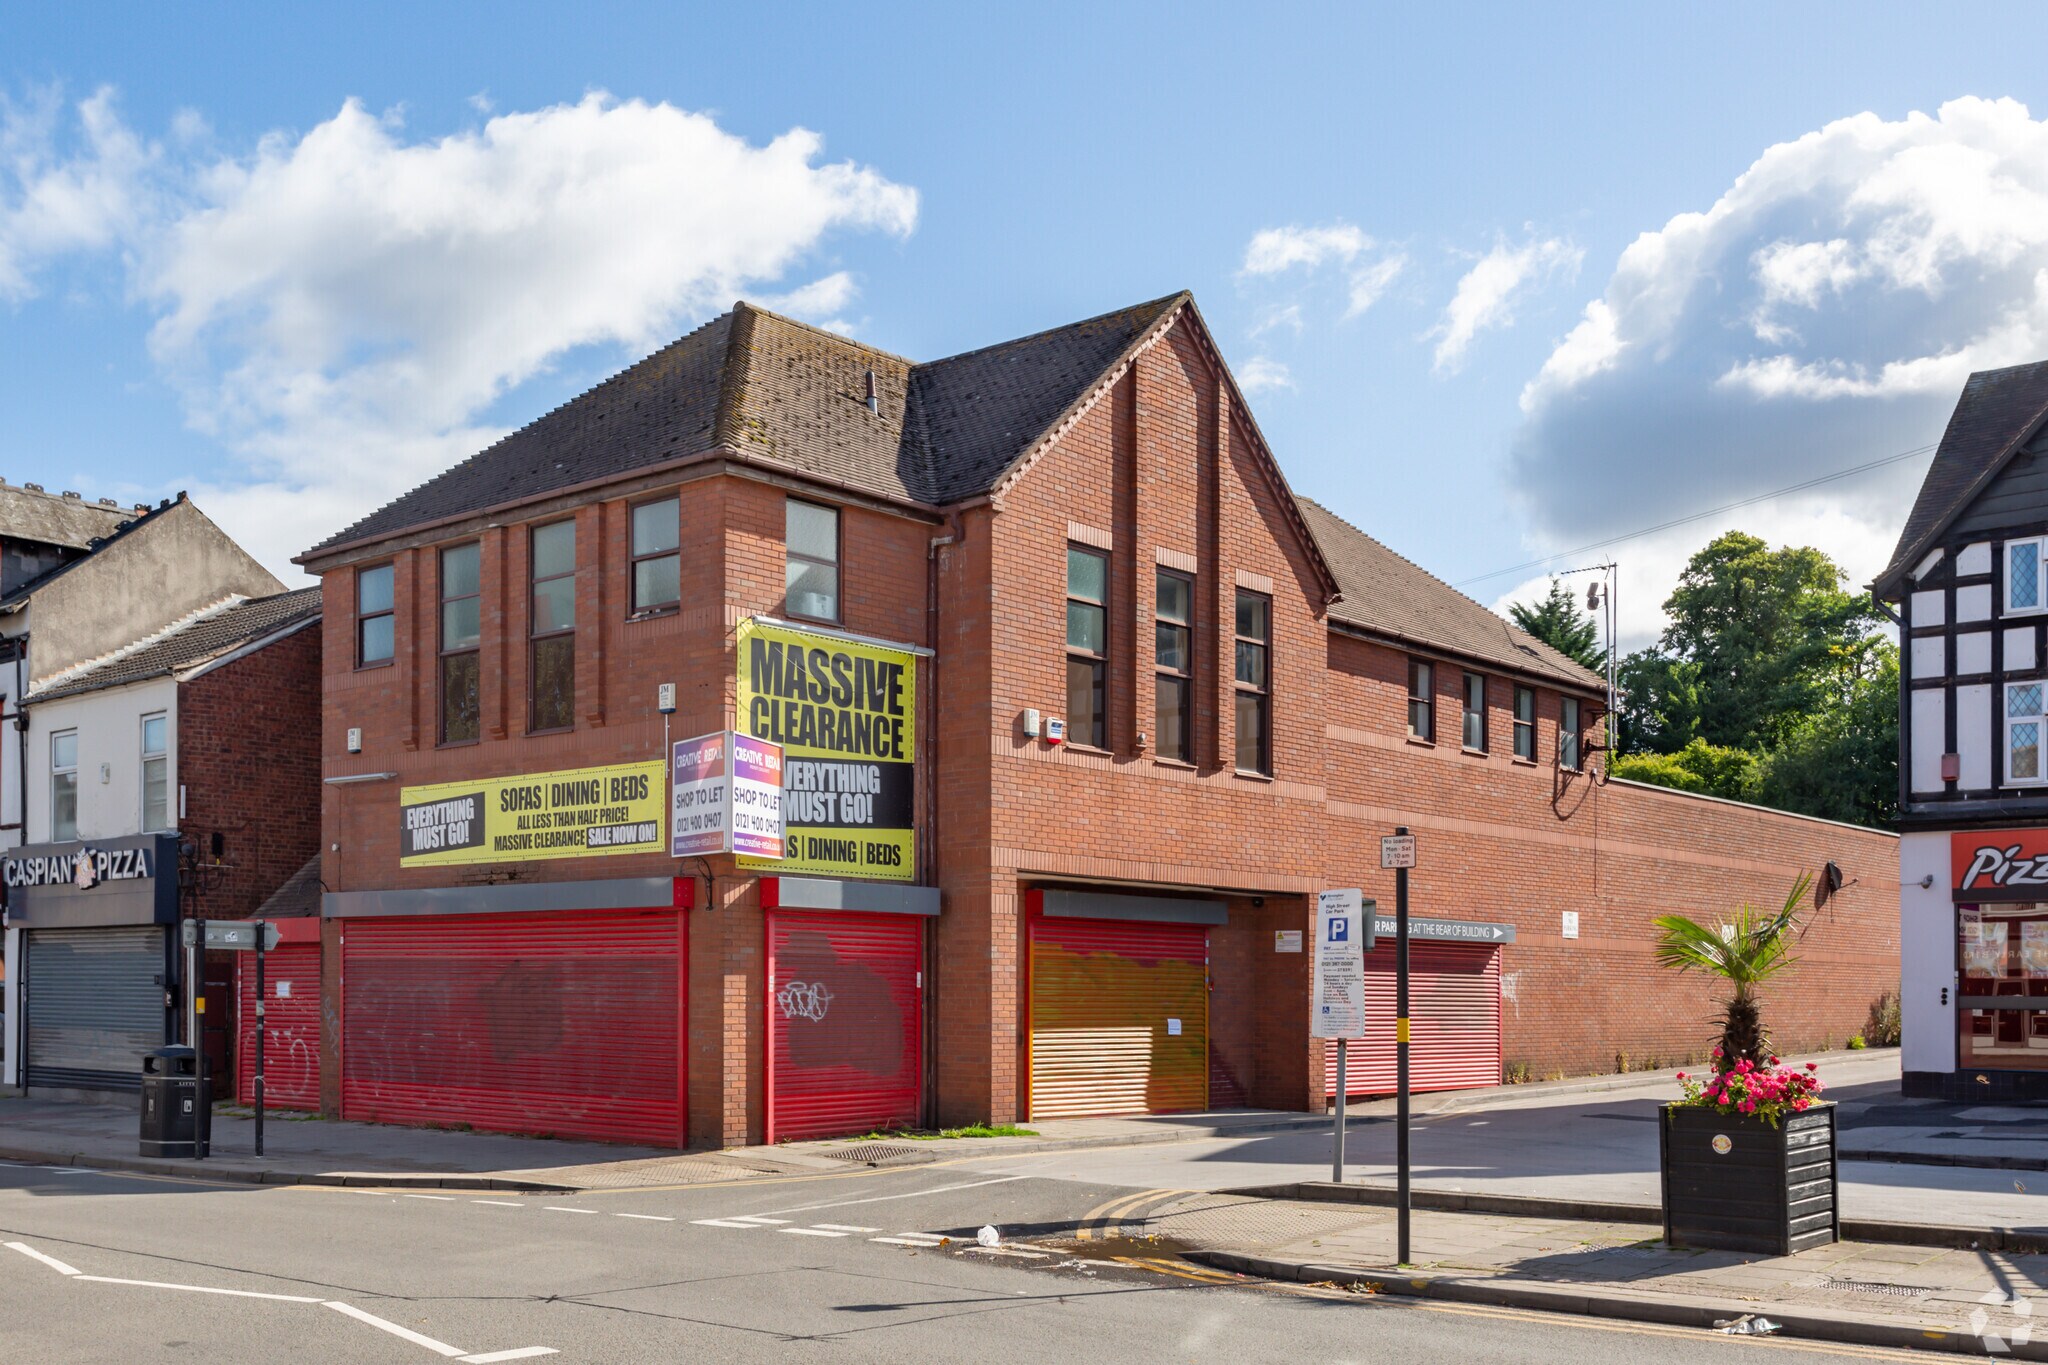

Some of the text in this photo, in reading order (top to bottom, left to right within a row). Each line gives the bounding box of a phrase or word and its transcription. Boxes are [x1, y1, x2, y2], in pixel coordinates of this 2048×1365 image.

[751, 638, 904, 716] MASSIVE
[751, 696, 904, 759] CLEARANCE
[677, 751, 701, 768] CREATIVE
[704, 746, 723, 762] RETAIL
[735, 746, 763, 766] CREATIVE
[765, 754, 781, 770] RETAIL
[786, 761, 880, 794] VERYTHING
[501, 774, 648, 812] SOFAS DINING BEDS
[677, 786, 724, 809] SHOP TO LET
[735, 787, 782, 810] SHOP TO LET
[407, 798, 474, 830] EVERYTHING
[517, 807, 628, 830] ALL LESS THAN HALF PRICE!
[786, 791, 873, 823] MUST GO!
[413, 821, 470, 850] MUST GO!
[677, 812, 722, 832] 0121 400 0407
[736, 813, 780, 834] 0121 400 0407
[494, 824, 656, 851] MASSIVE CLEARANCE SALE NOW ON!
[809, 837, 856, 863] DINING
[867, 843, 901, 866] BEDS
[7, 849, 147, 887] CASPIAN PIZZA
[1332, 920, 1345, 940] P
[1382, 922, 1412, 933] PARG
[1413, 924, 1421, 934] AT
[1422, 924, 1435, 935] THE
[1436, 925, 1452, 936] REAR
[1452, 926, 1461, 936] OF
[1462, 926, 1489, 938] BUILDING
